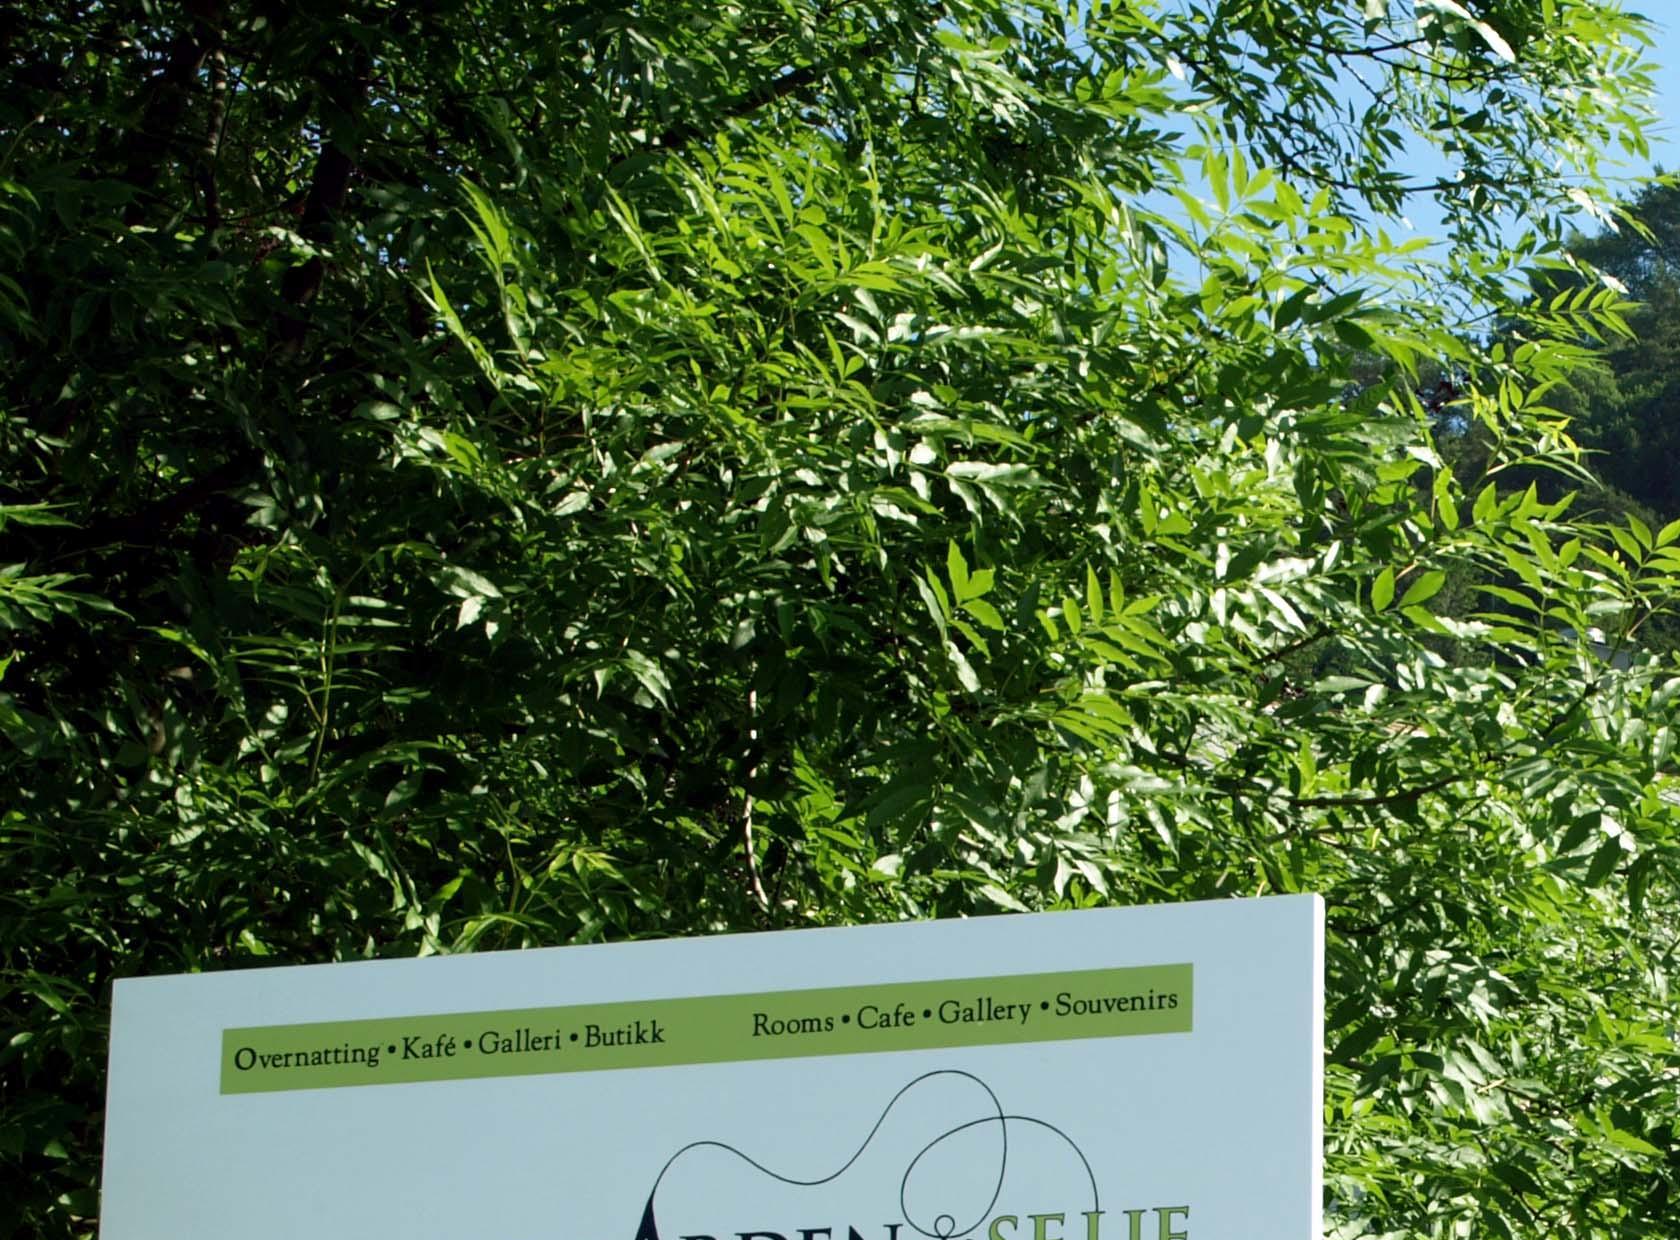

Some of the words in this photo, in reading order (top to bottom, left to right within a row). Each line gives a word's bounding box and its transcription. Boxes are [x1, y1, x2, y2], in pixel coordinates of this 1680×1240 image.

[752, 1012, 834, 1036] Rooms
[857, 1003, 915, 1030] Cafe
[938, 997, 1031, 1026] Gallery
[1055, 989, 1178, 1017] Souvenirs
[234, 1041, 380, 1071] Overnatting
[402, 1036, 456, 1060] Kafé
[478, 1028, 562, 1055] Galleri
[584, 1020, 665, 1048] Butikk
